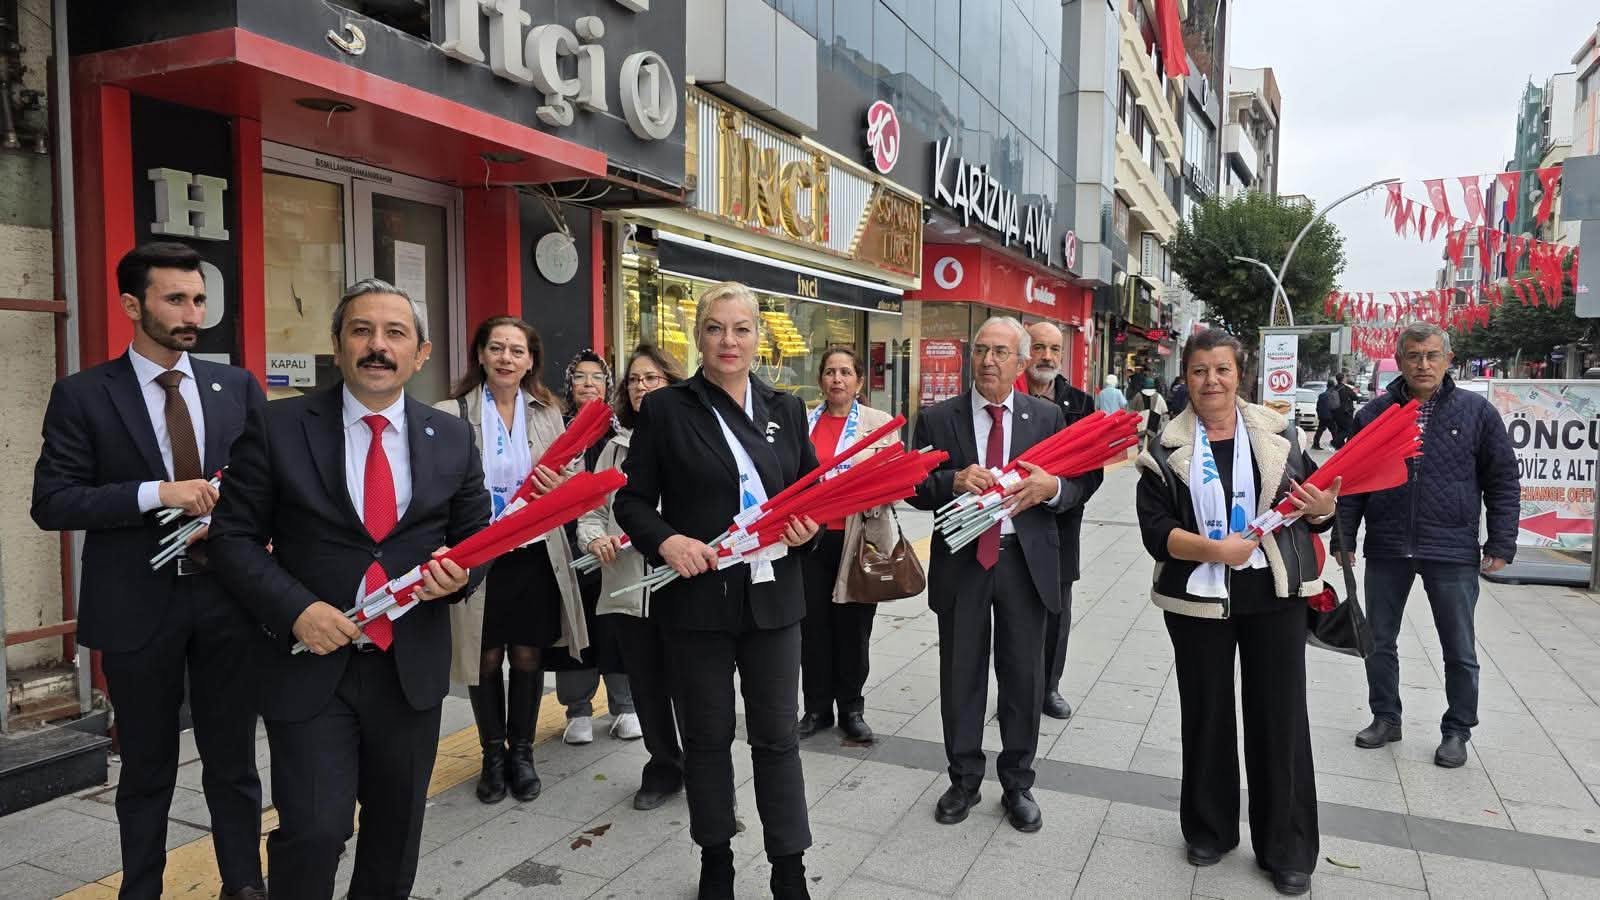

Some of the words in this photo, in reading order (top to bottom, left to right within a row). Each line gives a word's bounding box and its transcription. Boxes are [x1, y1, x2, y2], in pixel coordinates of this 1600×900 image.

[934, 135, 1020, 247] KARİZMA
[1024, 200, 1053, 267] AVM
[797, 273, 819, 299] İNCİ
[271, 359, 306, 369] KAPALI
[1271, 373, 1290, 389] 90
[1517, 453, 1548, 480] ÖVİZ
[1552, 458, 1561, 480] &
